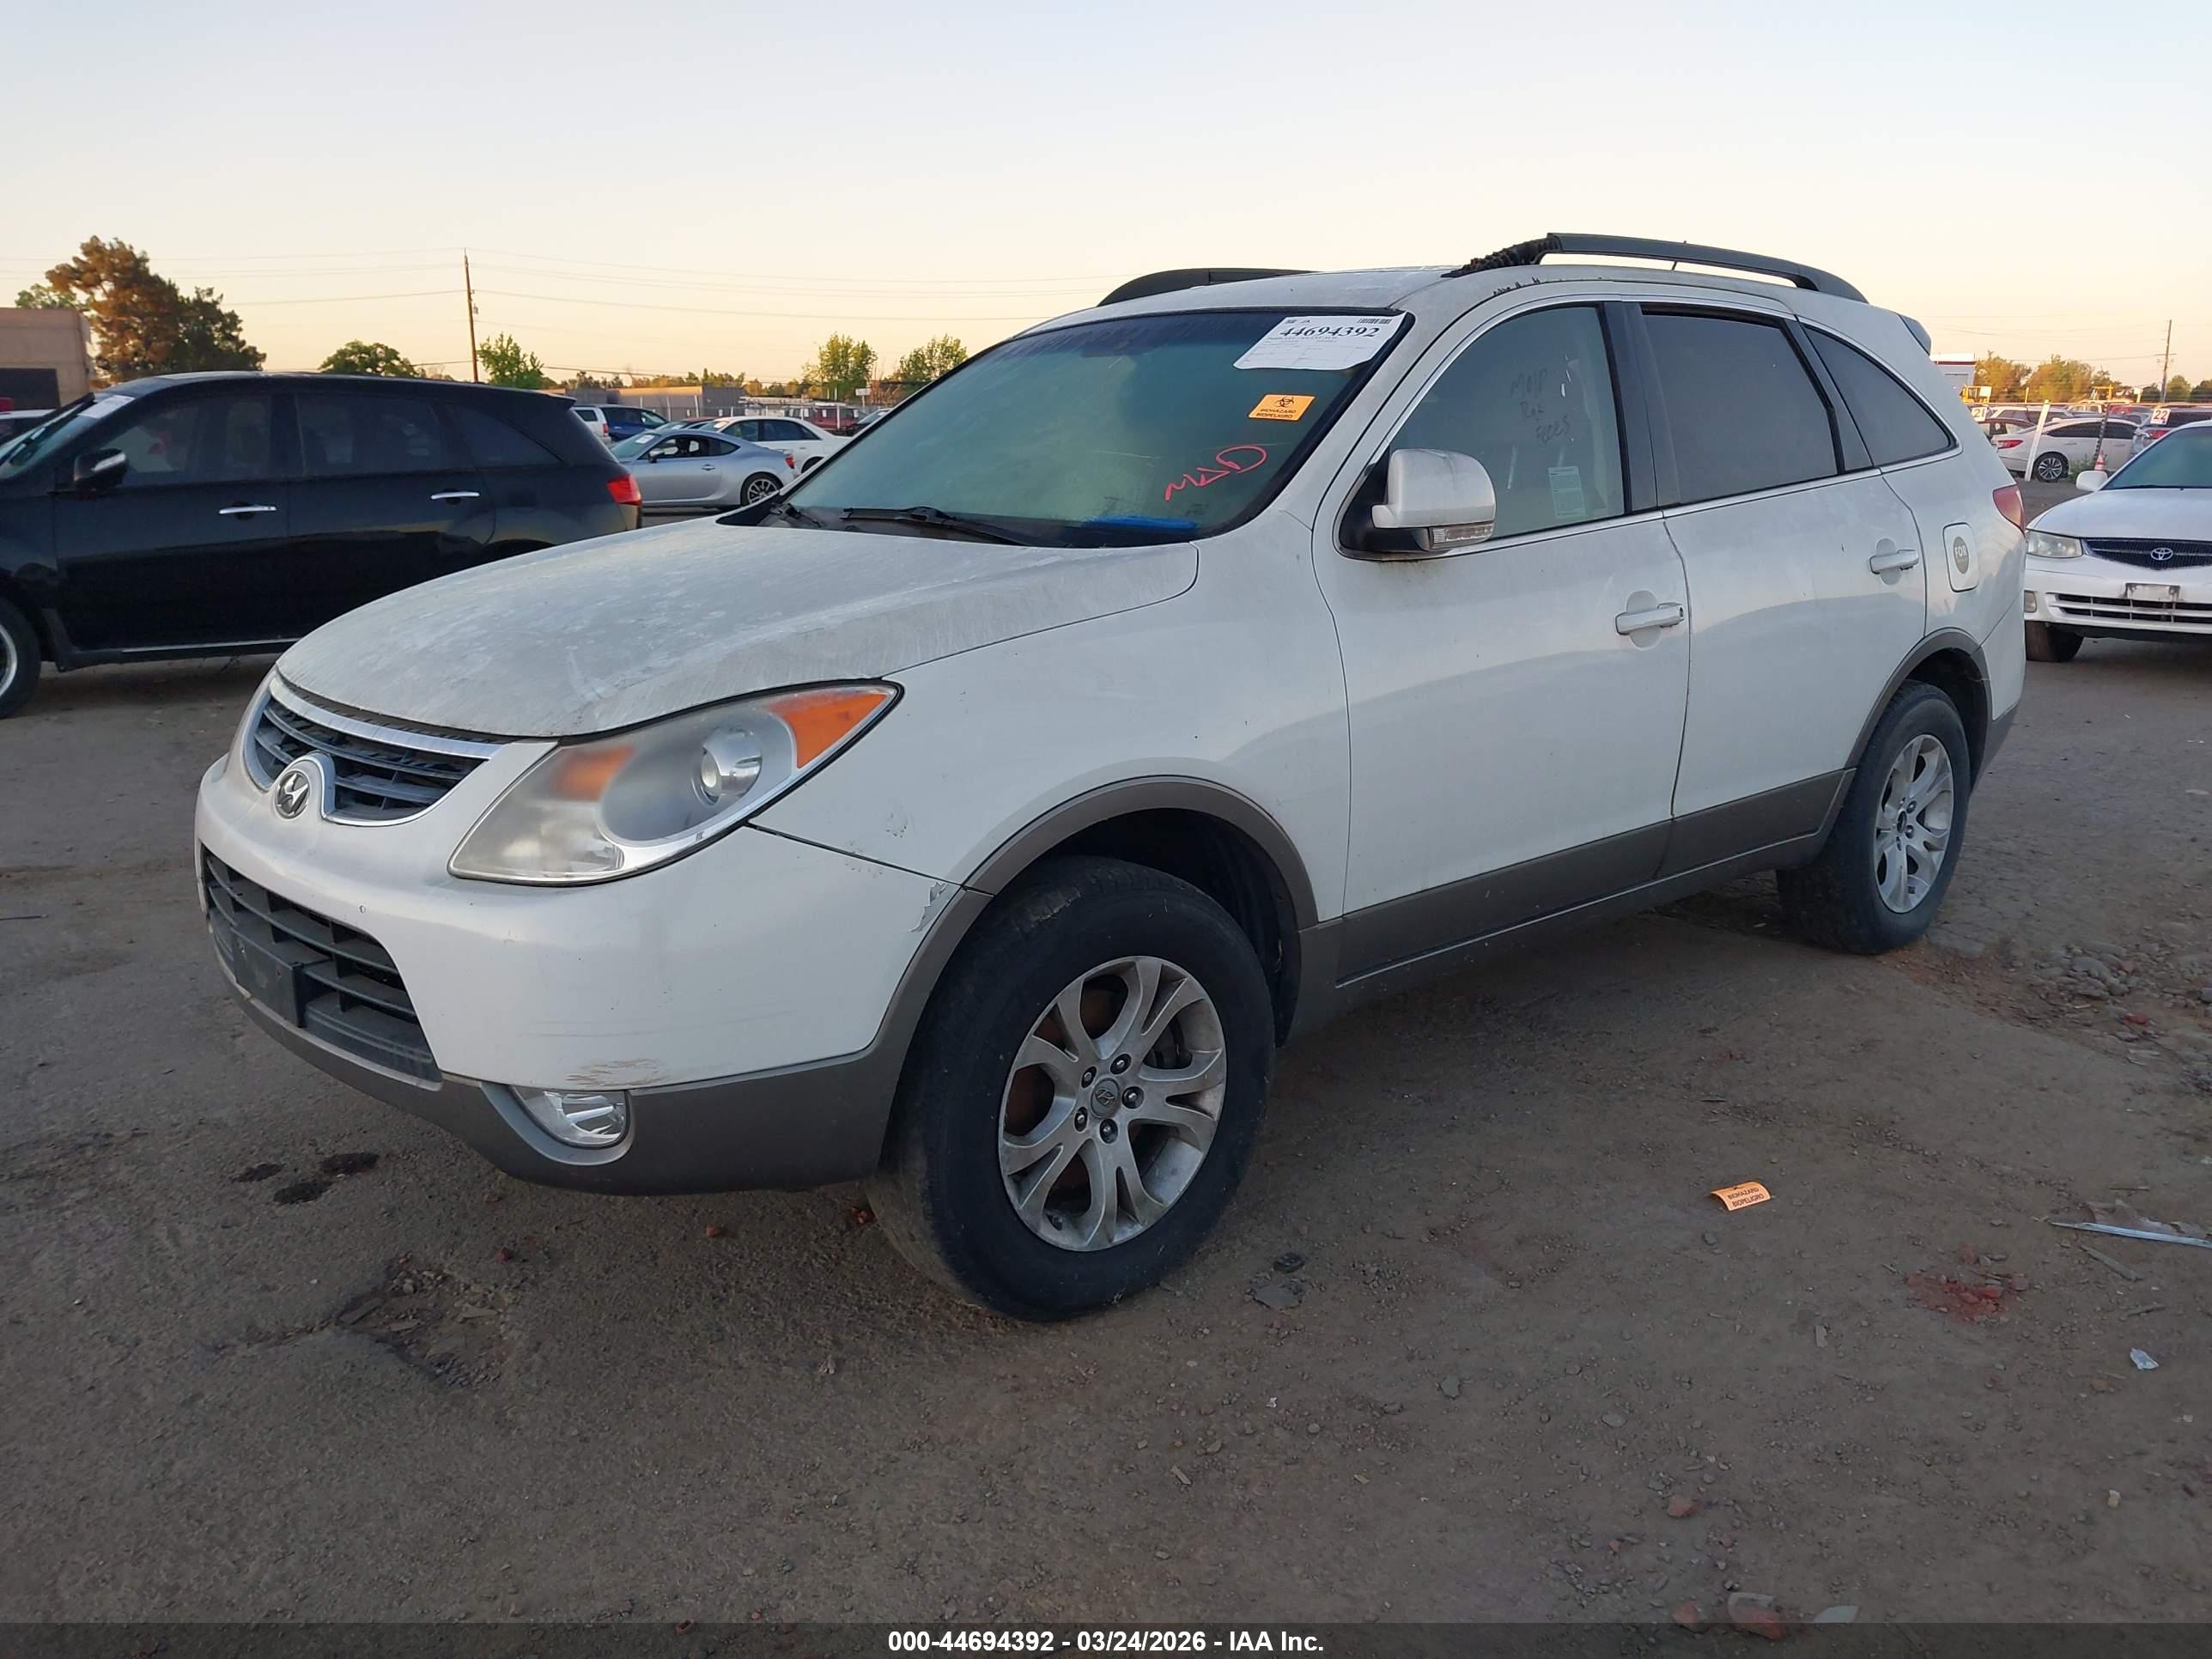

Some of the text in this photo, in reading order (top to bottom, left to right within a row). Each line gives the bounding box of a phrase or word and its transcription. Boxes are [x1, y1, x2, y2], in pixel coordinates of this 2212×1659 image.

[1280, 326, 1381, 337] 44694392
[1974, 408, 1984, 417] 21
[2154, 410, 2167, 420] 22
[1727, 1188, 1759, 1200] BIOHAZARD
[1732, 1194, 1765, 1206] BIOPELIGRO
